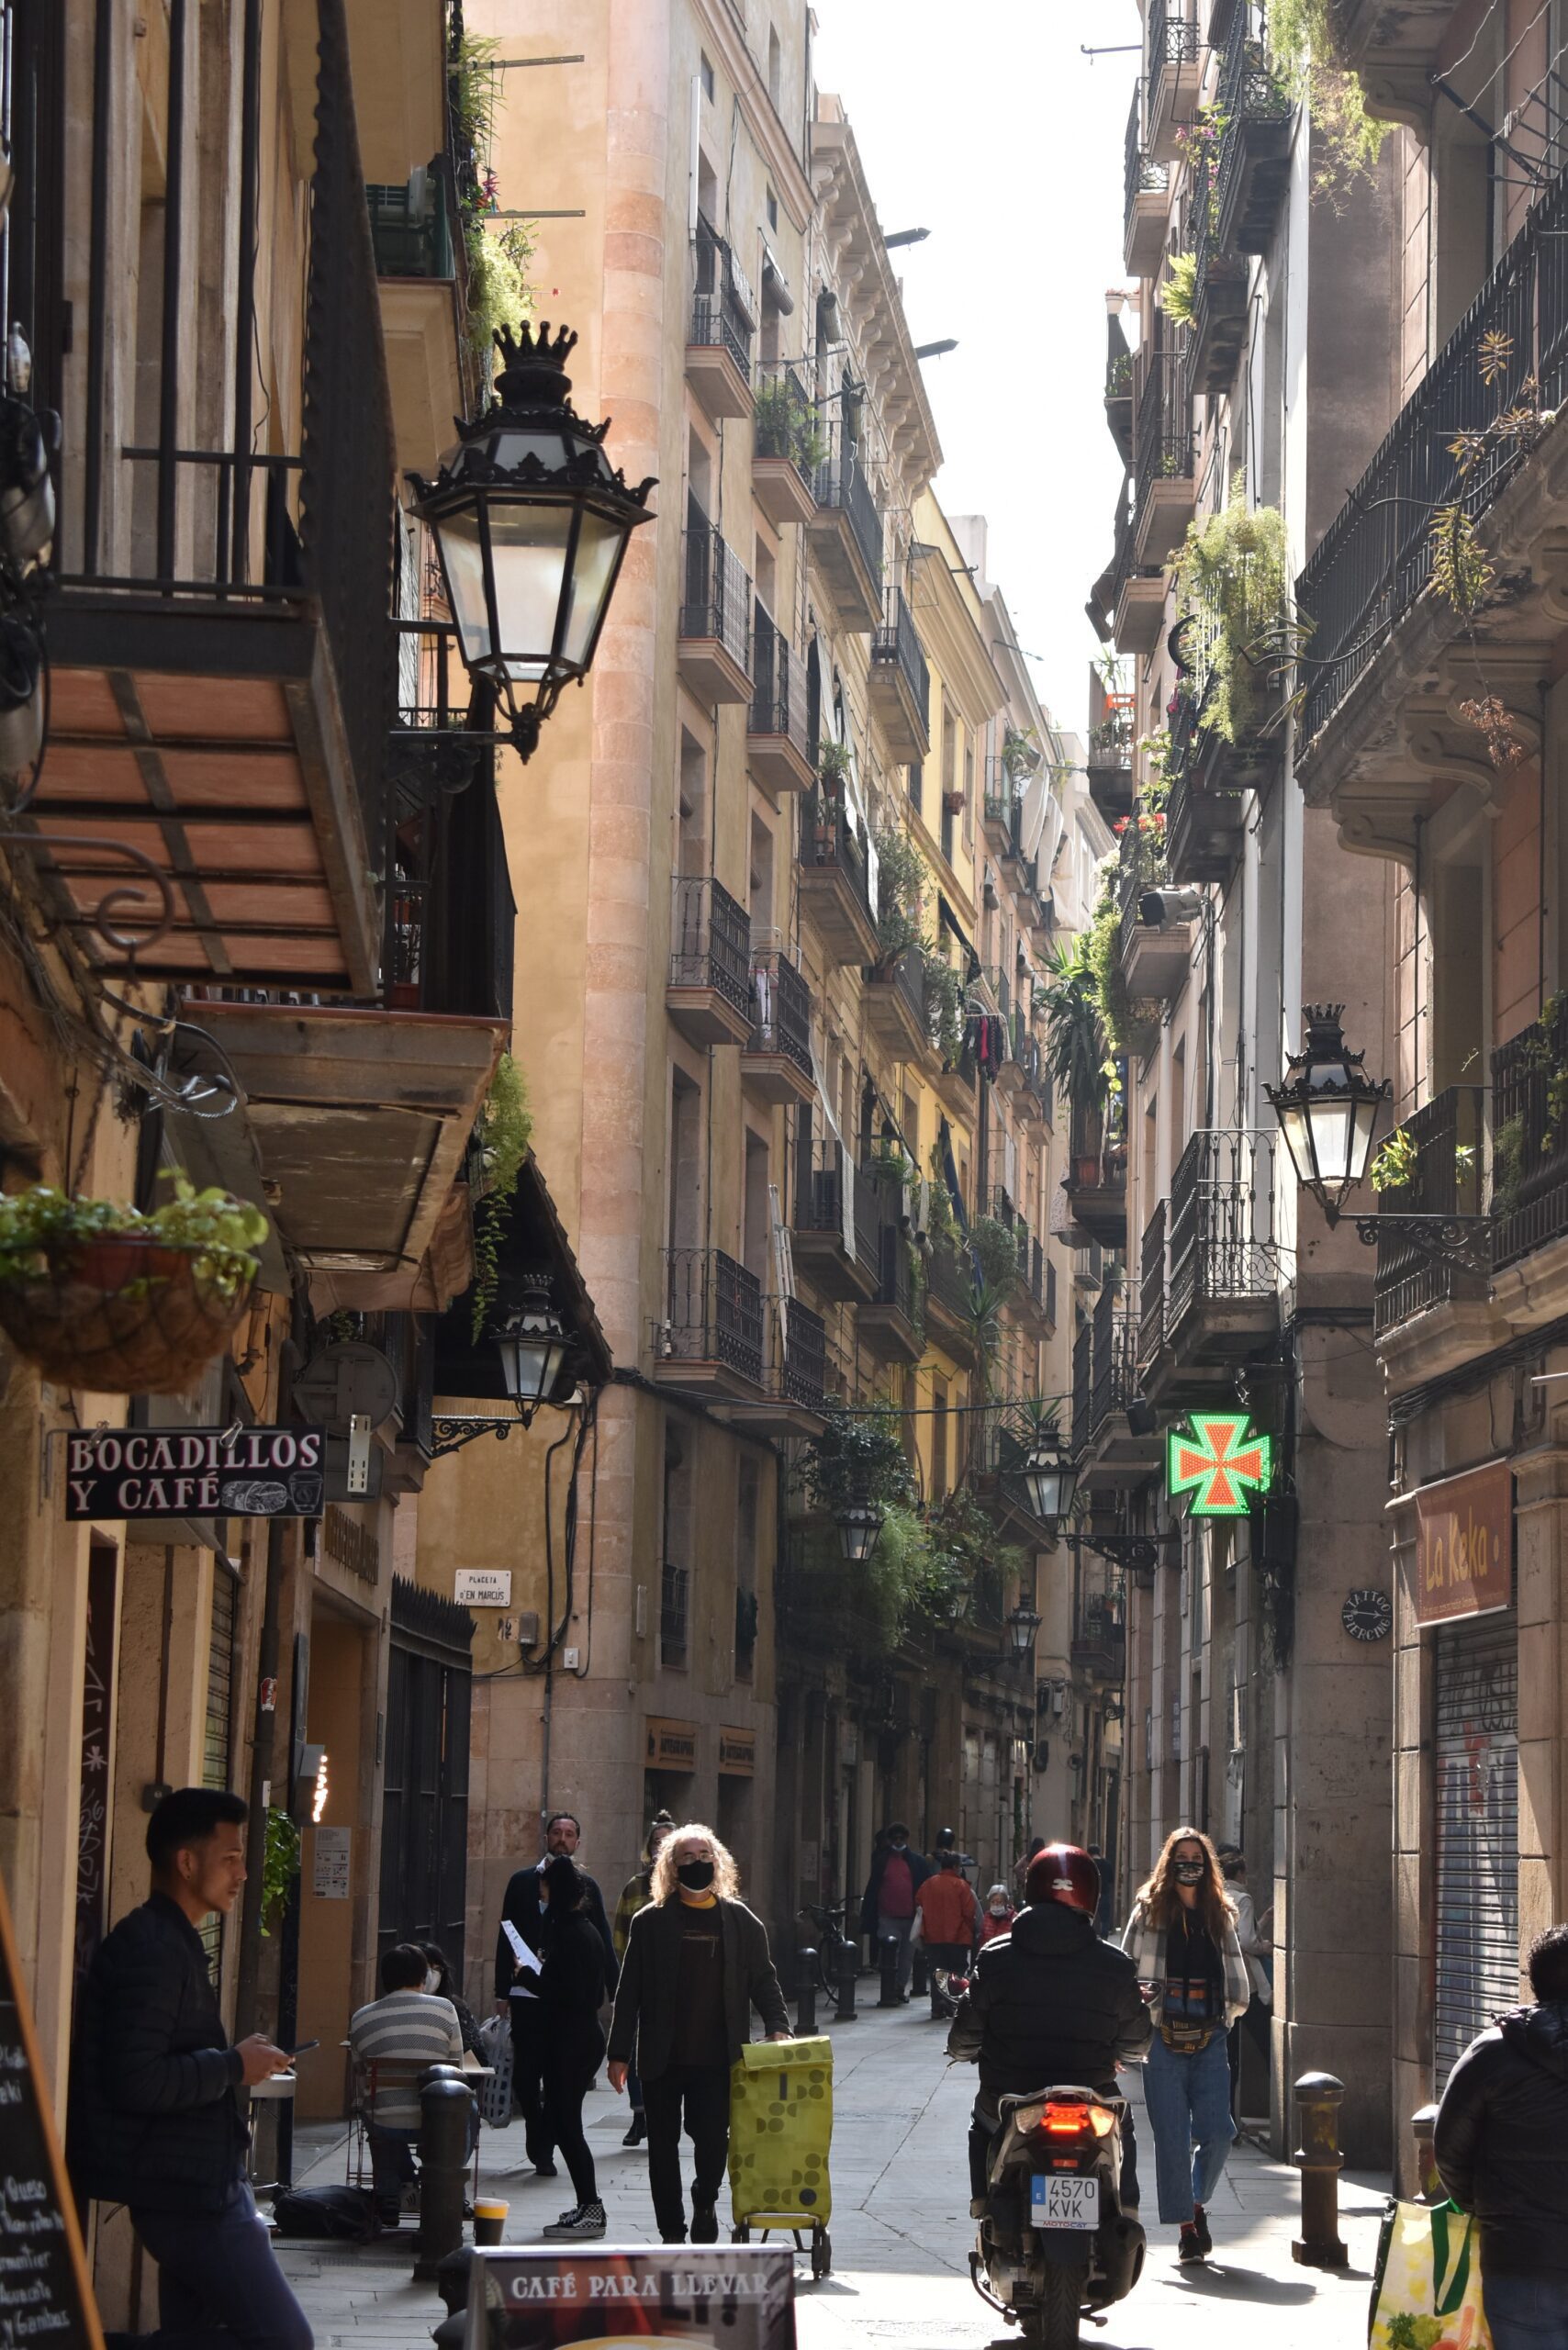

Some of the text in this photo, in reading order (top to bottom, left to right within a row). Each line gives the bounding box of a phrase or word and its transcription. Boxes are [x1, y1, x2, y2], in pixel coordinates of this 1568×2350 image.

[70, 1434, 320, 1472] BOCADILLOS
[70, 1471, 220, 1511] Y CAFÉ
[1426, 1505, 1488, 1593] La Keka
[469, 1576, 497, 1584] PLACETA
[478, 1587, 504, 1600] MARCÚS
[1345, 1590, 1392, 1612] TATTOO
[1343, 1614, 1391, 1641] PIERCING
[1050, 2180, 1094, 2199] 4570
[1048, 2199, 1082, 2219] KVK
[1043, 2221, 1087, 2229] MOTOCAT
[511, 2272, 770, 2299] CAFÉ PARA LLEVAR
